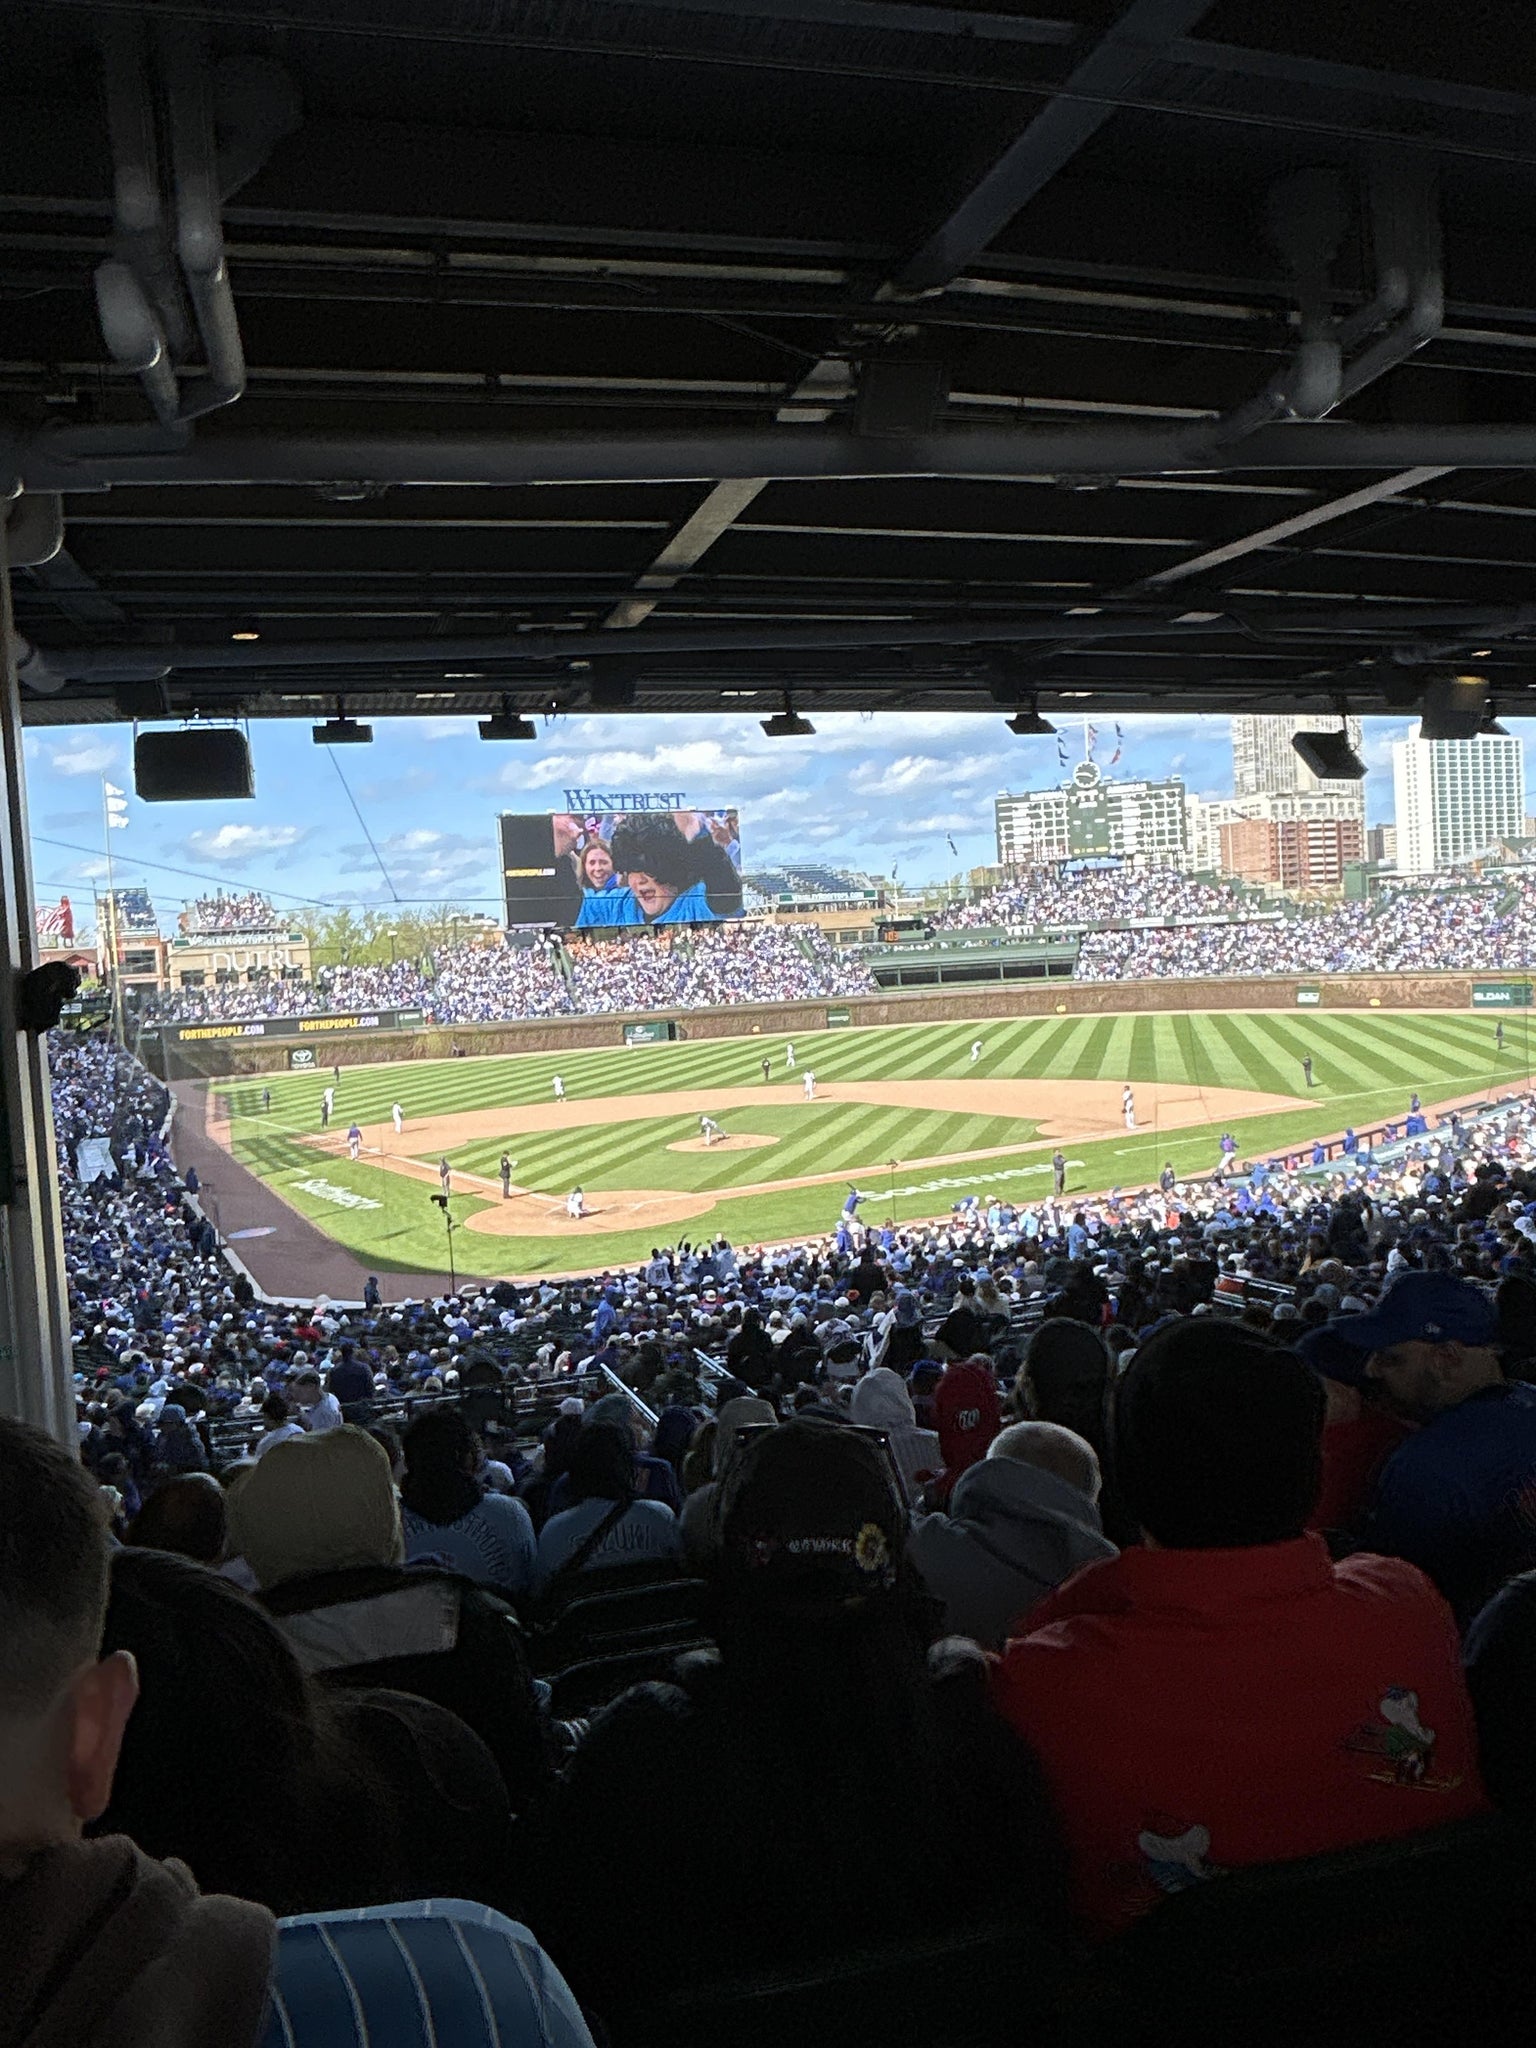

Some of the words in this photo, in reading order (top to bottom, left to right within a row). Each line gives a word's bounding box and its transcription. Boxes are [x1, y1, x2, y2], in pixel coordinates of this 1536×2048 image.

[563, 789, 686, 811] WINTRUST
[1175, 914, 1229, 925] Budweiser
[1006, 924, 1034, 936] YETI
[1473, 992, 1510, 1001] SLOAN
[568, 1521, 652, 1554] SZUKI
